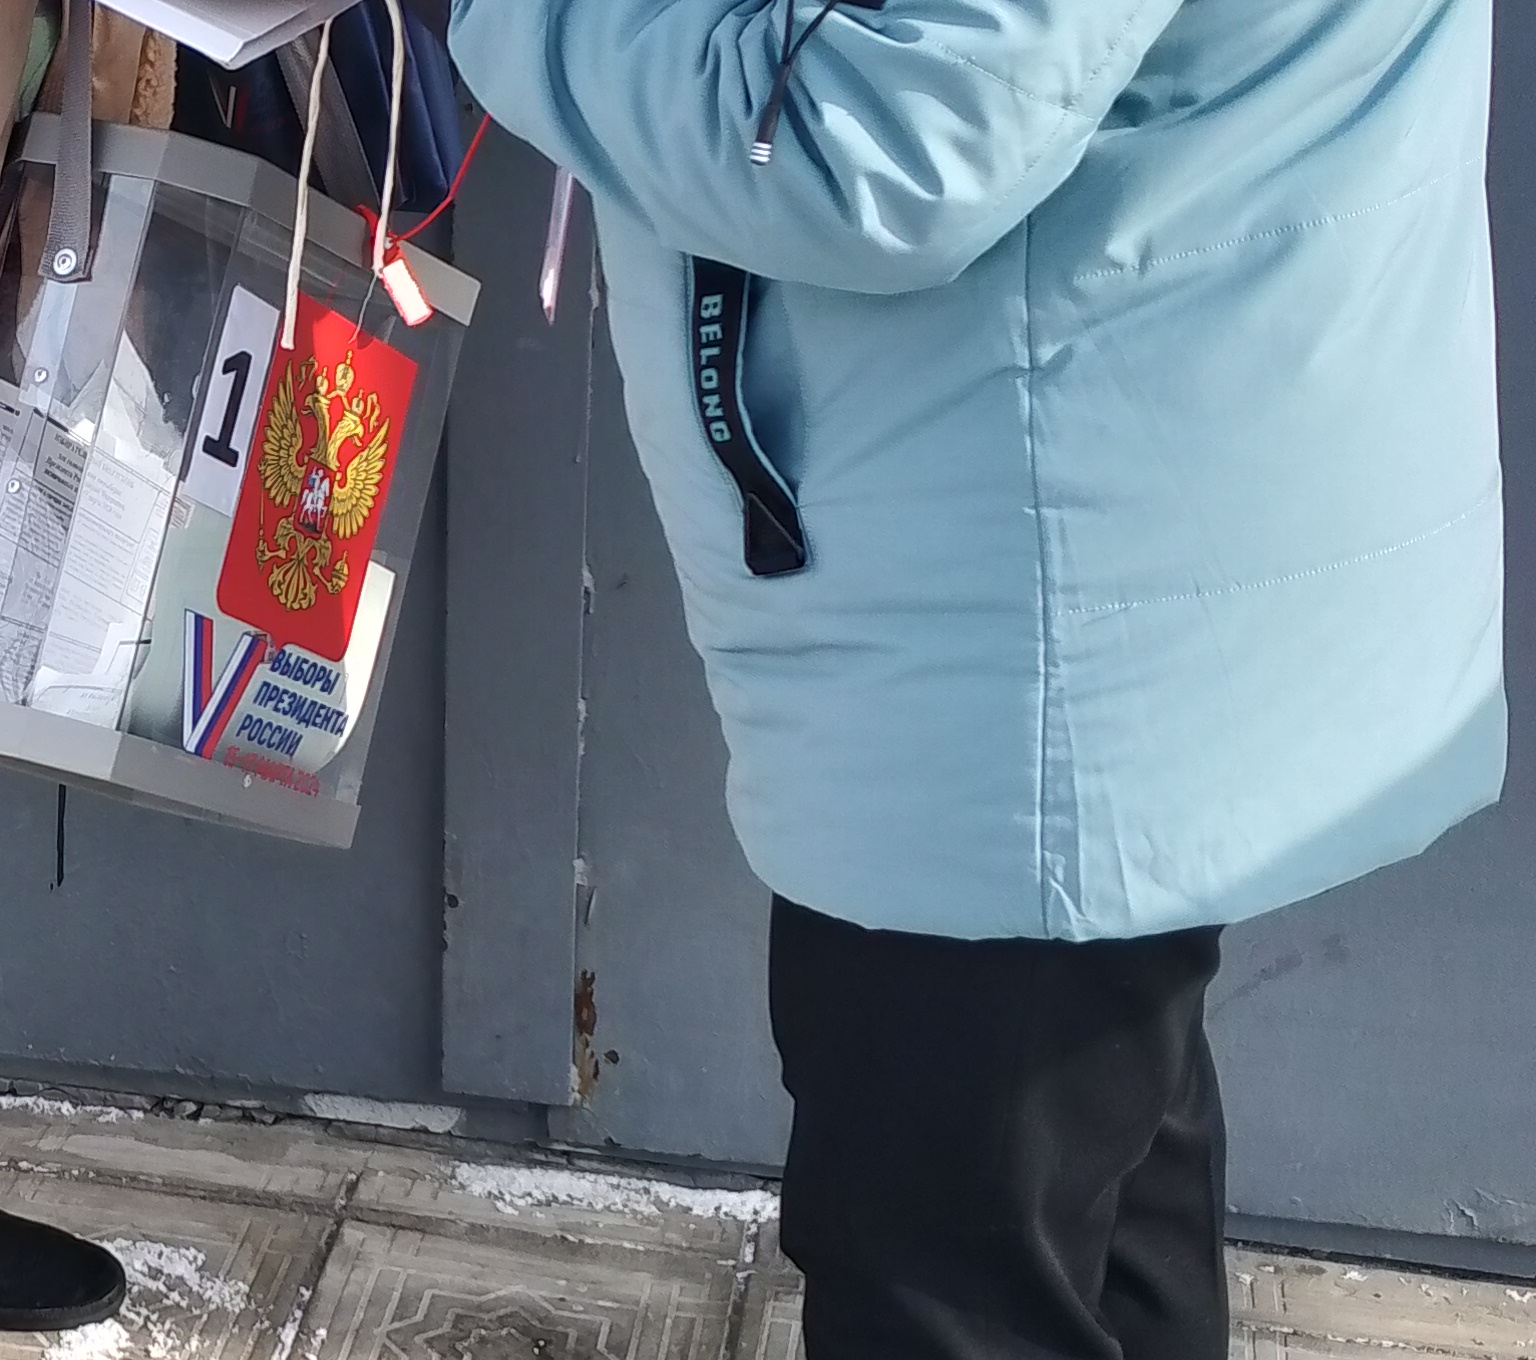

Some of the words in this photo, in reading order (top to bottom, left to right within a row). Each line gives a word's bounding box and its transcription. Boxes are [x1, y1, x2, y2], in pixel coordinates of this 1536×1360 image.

[699, 293, 732, 443] BELONG
[202, 350, 253, 469] 1
[269, 648, 341, 696] ВЫБОРЫ
[235, 713, 303, 759] РОССИИ
[253, 680, 349, 738] ПРЕЗИДЕНТА
